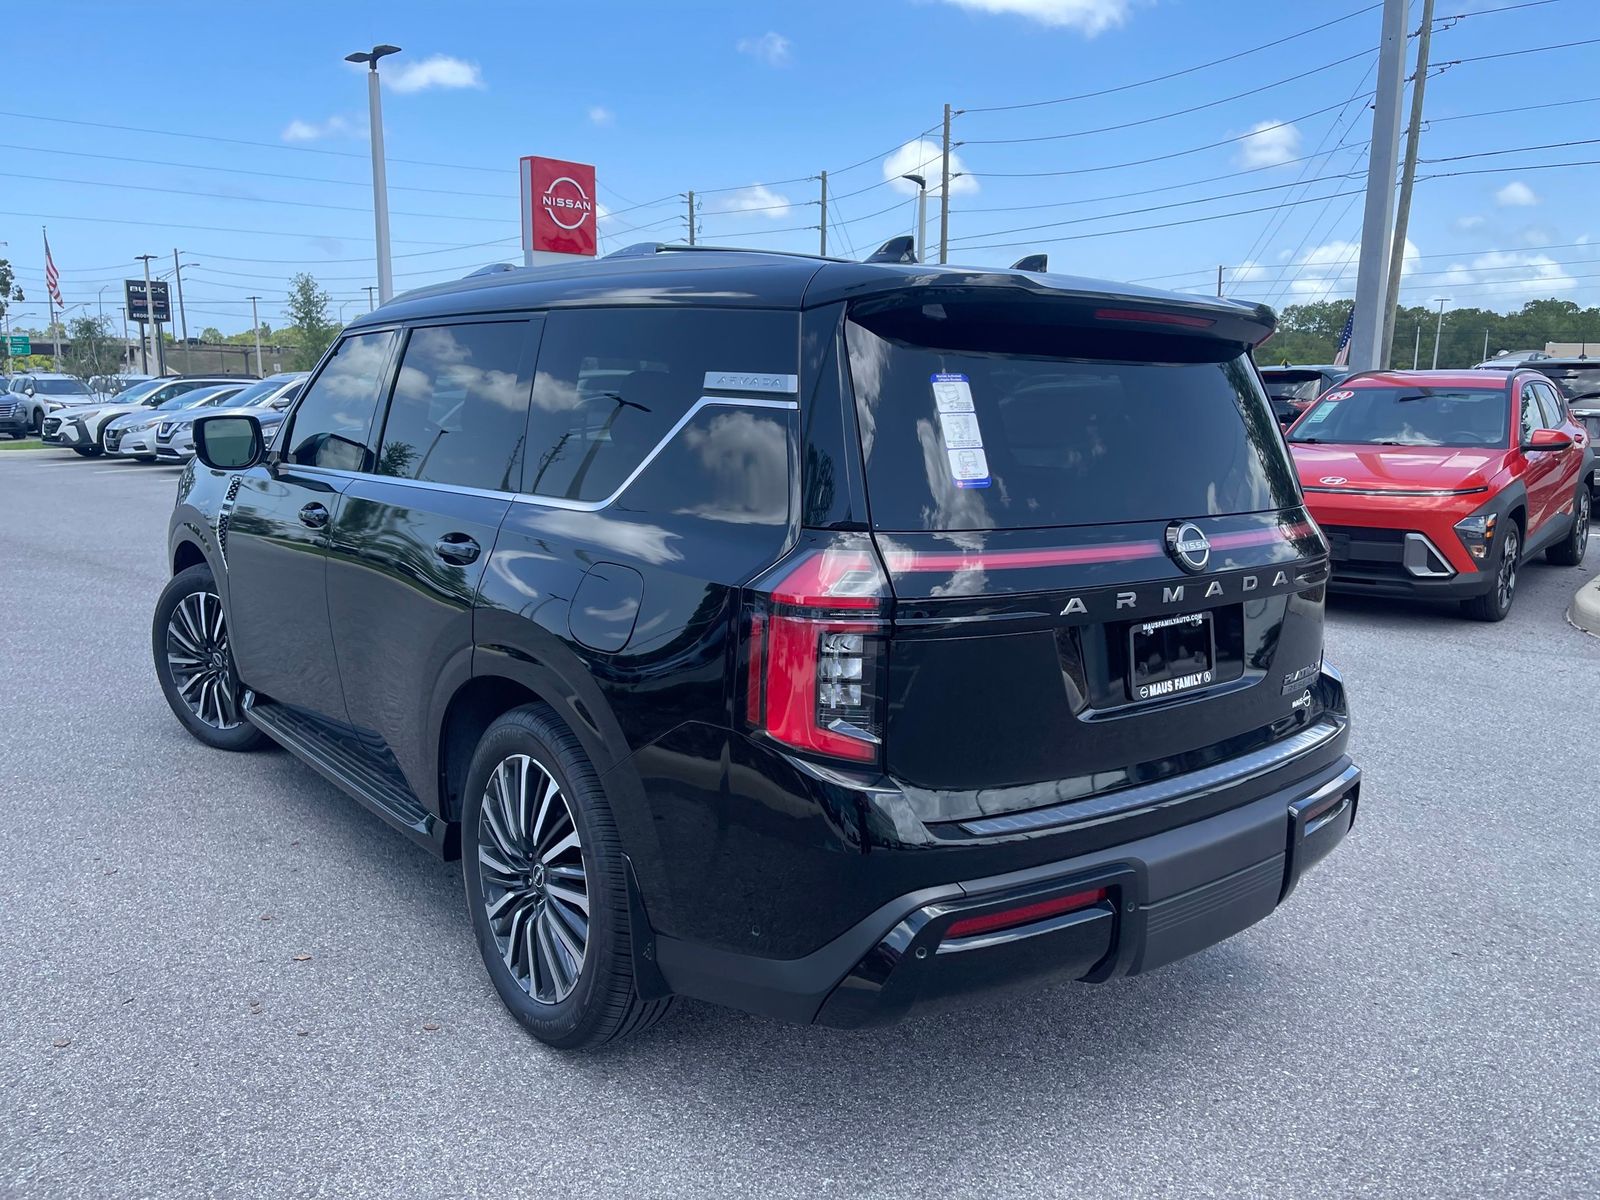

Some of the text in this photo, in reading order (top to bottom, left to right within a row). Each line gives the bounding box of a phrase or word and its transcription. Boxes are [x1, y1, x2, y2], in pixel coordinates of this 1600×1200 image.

[542, 195, 591, 211] NISSAN
[129, 286, 165, 294] BUCK
[1060, 571, 1288, 615] ARMADA
[1142, 613, 1203, 631] MAUSFAMILYAUTO.COM
[1149, 673, 1202, 697] MAUS FAMILY
